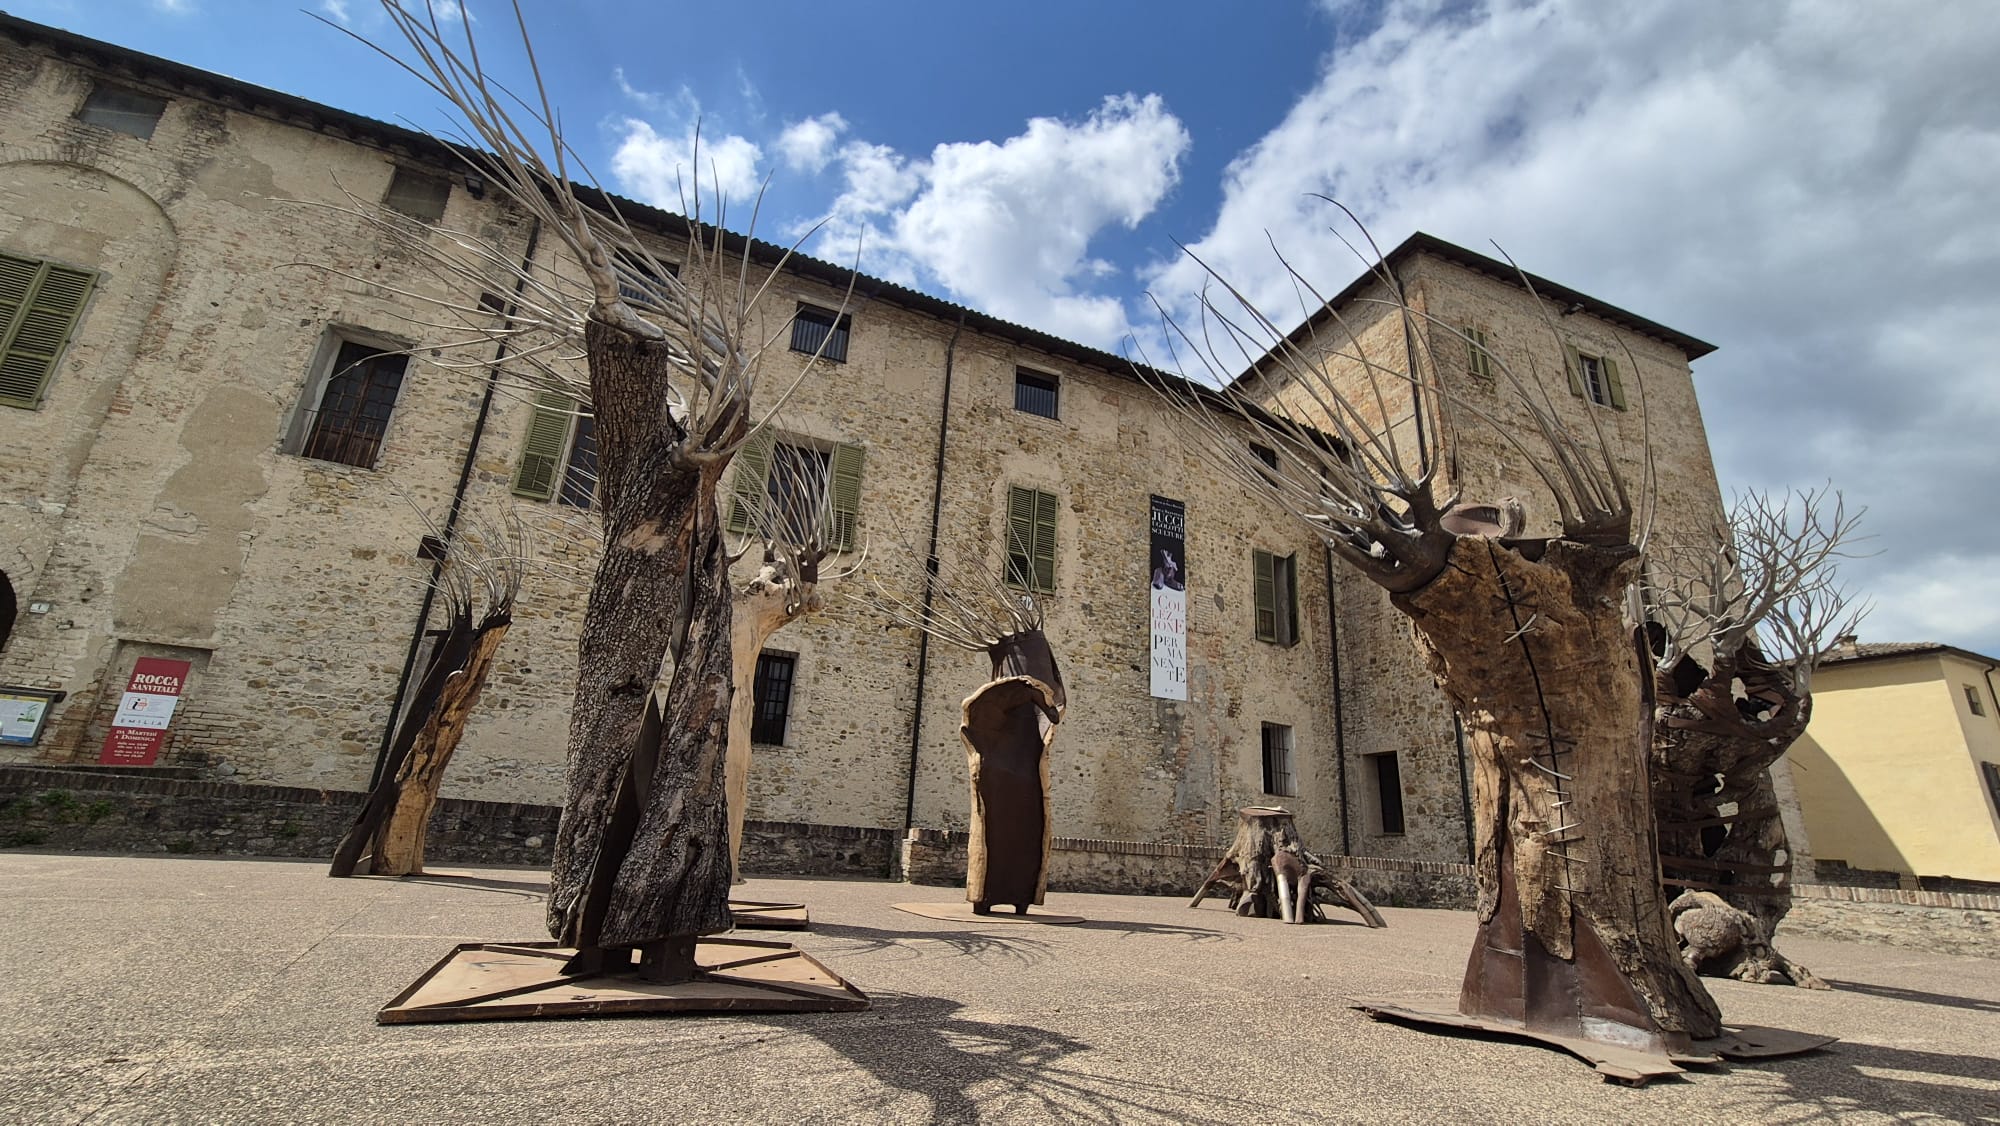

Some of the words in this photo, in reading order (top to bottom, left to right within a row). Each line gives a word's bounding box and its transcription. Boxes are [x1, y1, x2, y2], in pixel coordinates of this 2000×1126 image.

[1152, 511, 1184, 528] JUCCI
[1152, 528, 1184, 540] SCULTURE
[1158, 595, 1184, 612] COL
[1152, 608, 1172, 620] LEZ
[1154, 618, 1184, 635] IONE
[1154, 634, 1178, 649] PER
[1168, 648, 1183, 660] MA
[1153, 656, 1174, 668] NEN
[134, 673, 179, 686] ROCCA
[1167, 667, 1185, 683] TE
[131, 683, 178, 693] SANVITALE
